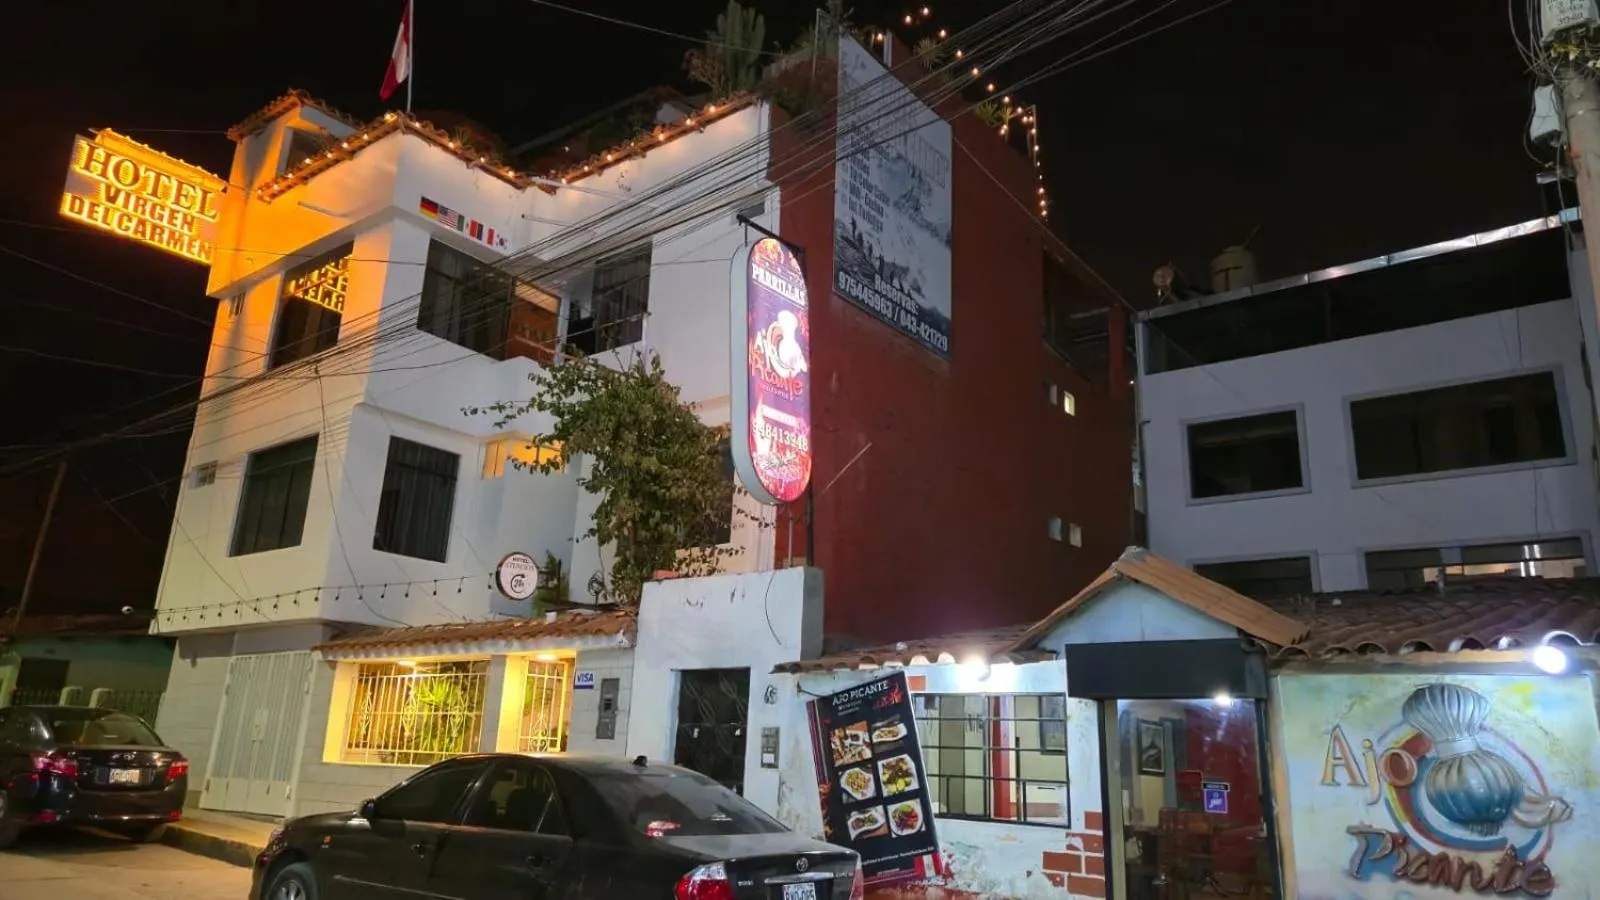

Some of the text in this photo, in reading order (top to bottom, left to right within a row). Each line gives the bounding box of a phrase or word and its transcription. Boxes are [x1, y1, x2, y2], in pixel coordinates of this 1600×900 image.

[74, 140, 219, 221] HOTEL
[102, 183, 196, 234] VIRGEN
[752, 262, 805, 306] PARRILLAS
[875, 272, 919, 315] Reservas:
[577, 672, 594, 683] VISA
[832, 693, 848, 706] AJO
[850, 680, 889, 700] PICANTE
[1321, 724, 1418, 805] Ajo
[1346, 825, 1556, 898] Picante
